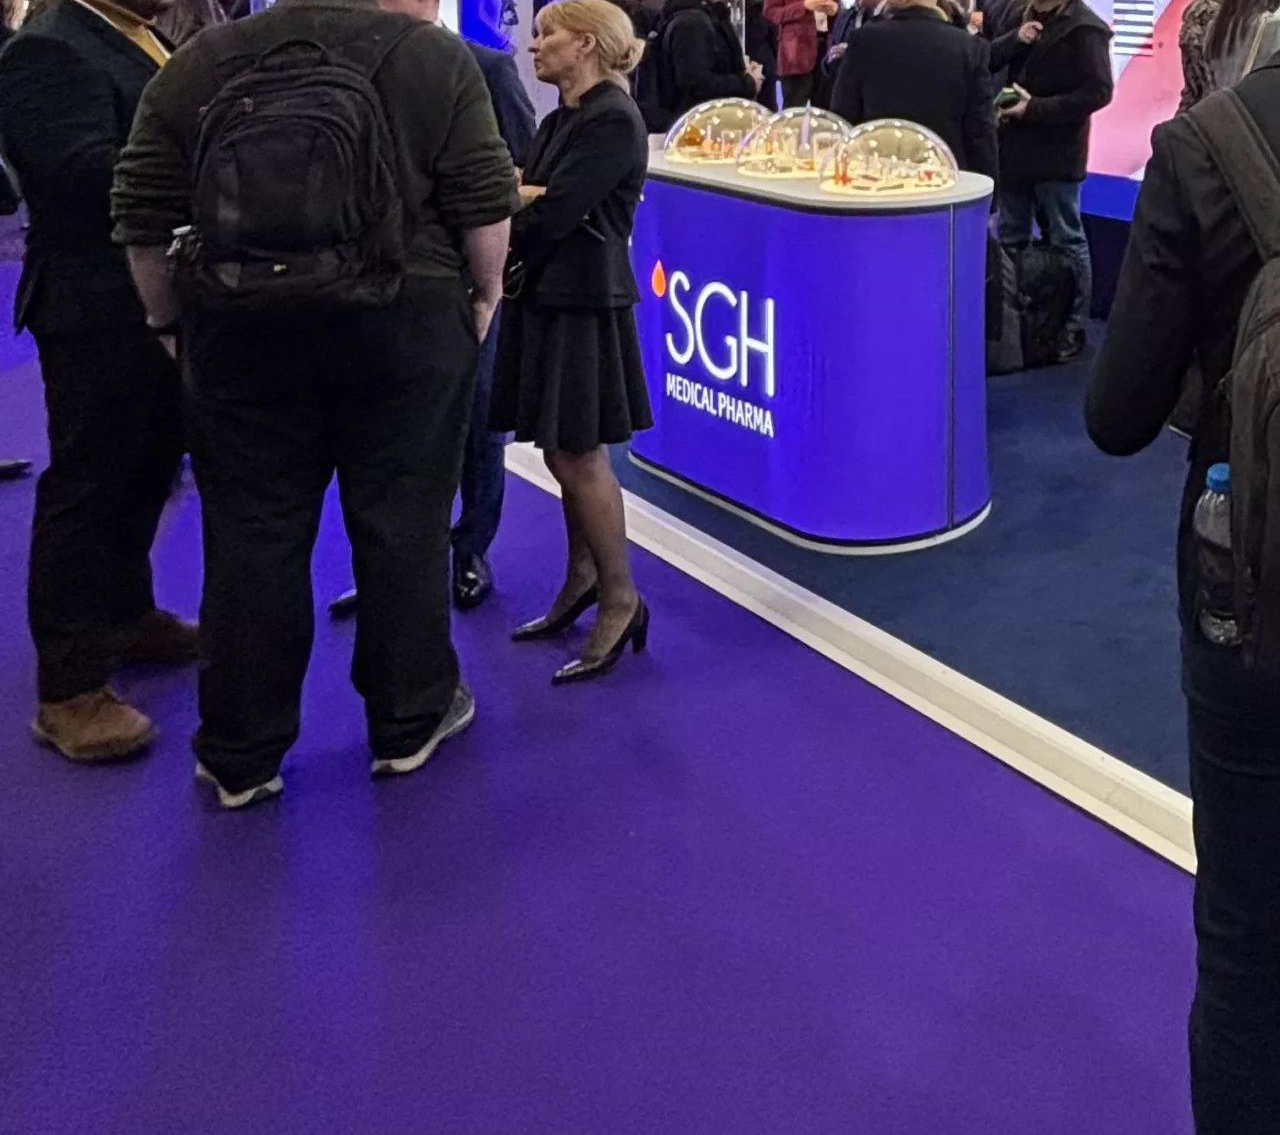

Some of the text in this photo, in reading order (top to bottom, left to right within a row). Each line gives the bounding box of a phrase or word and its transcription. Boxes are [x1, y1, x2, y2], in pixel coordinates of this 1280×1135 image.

[665, 270, 775, 399] SGH
[666, 372, 774, 439] MEDICAL PHARMA
